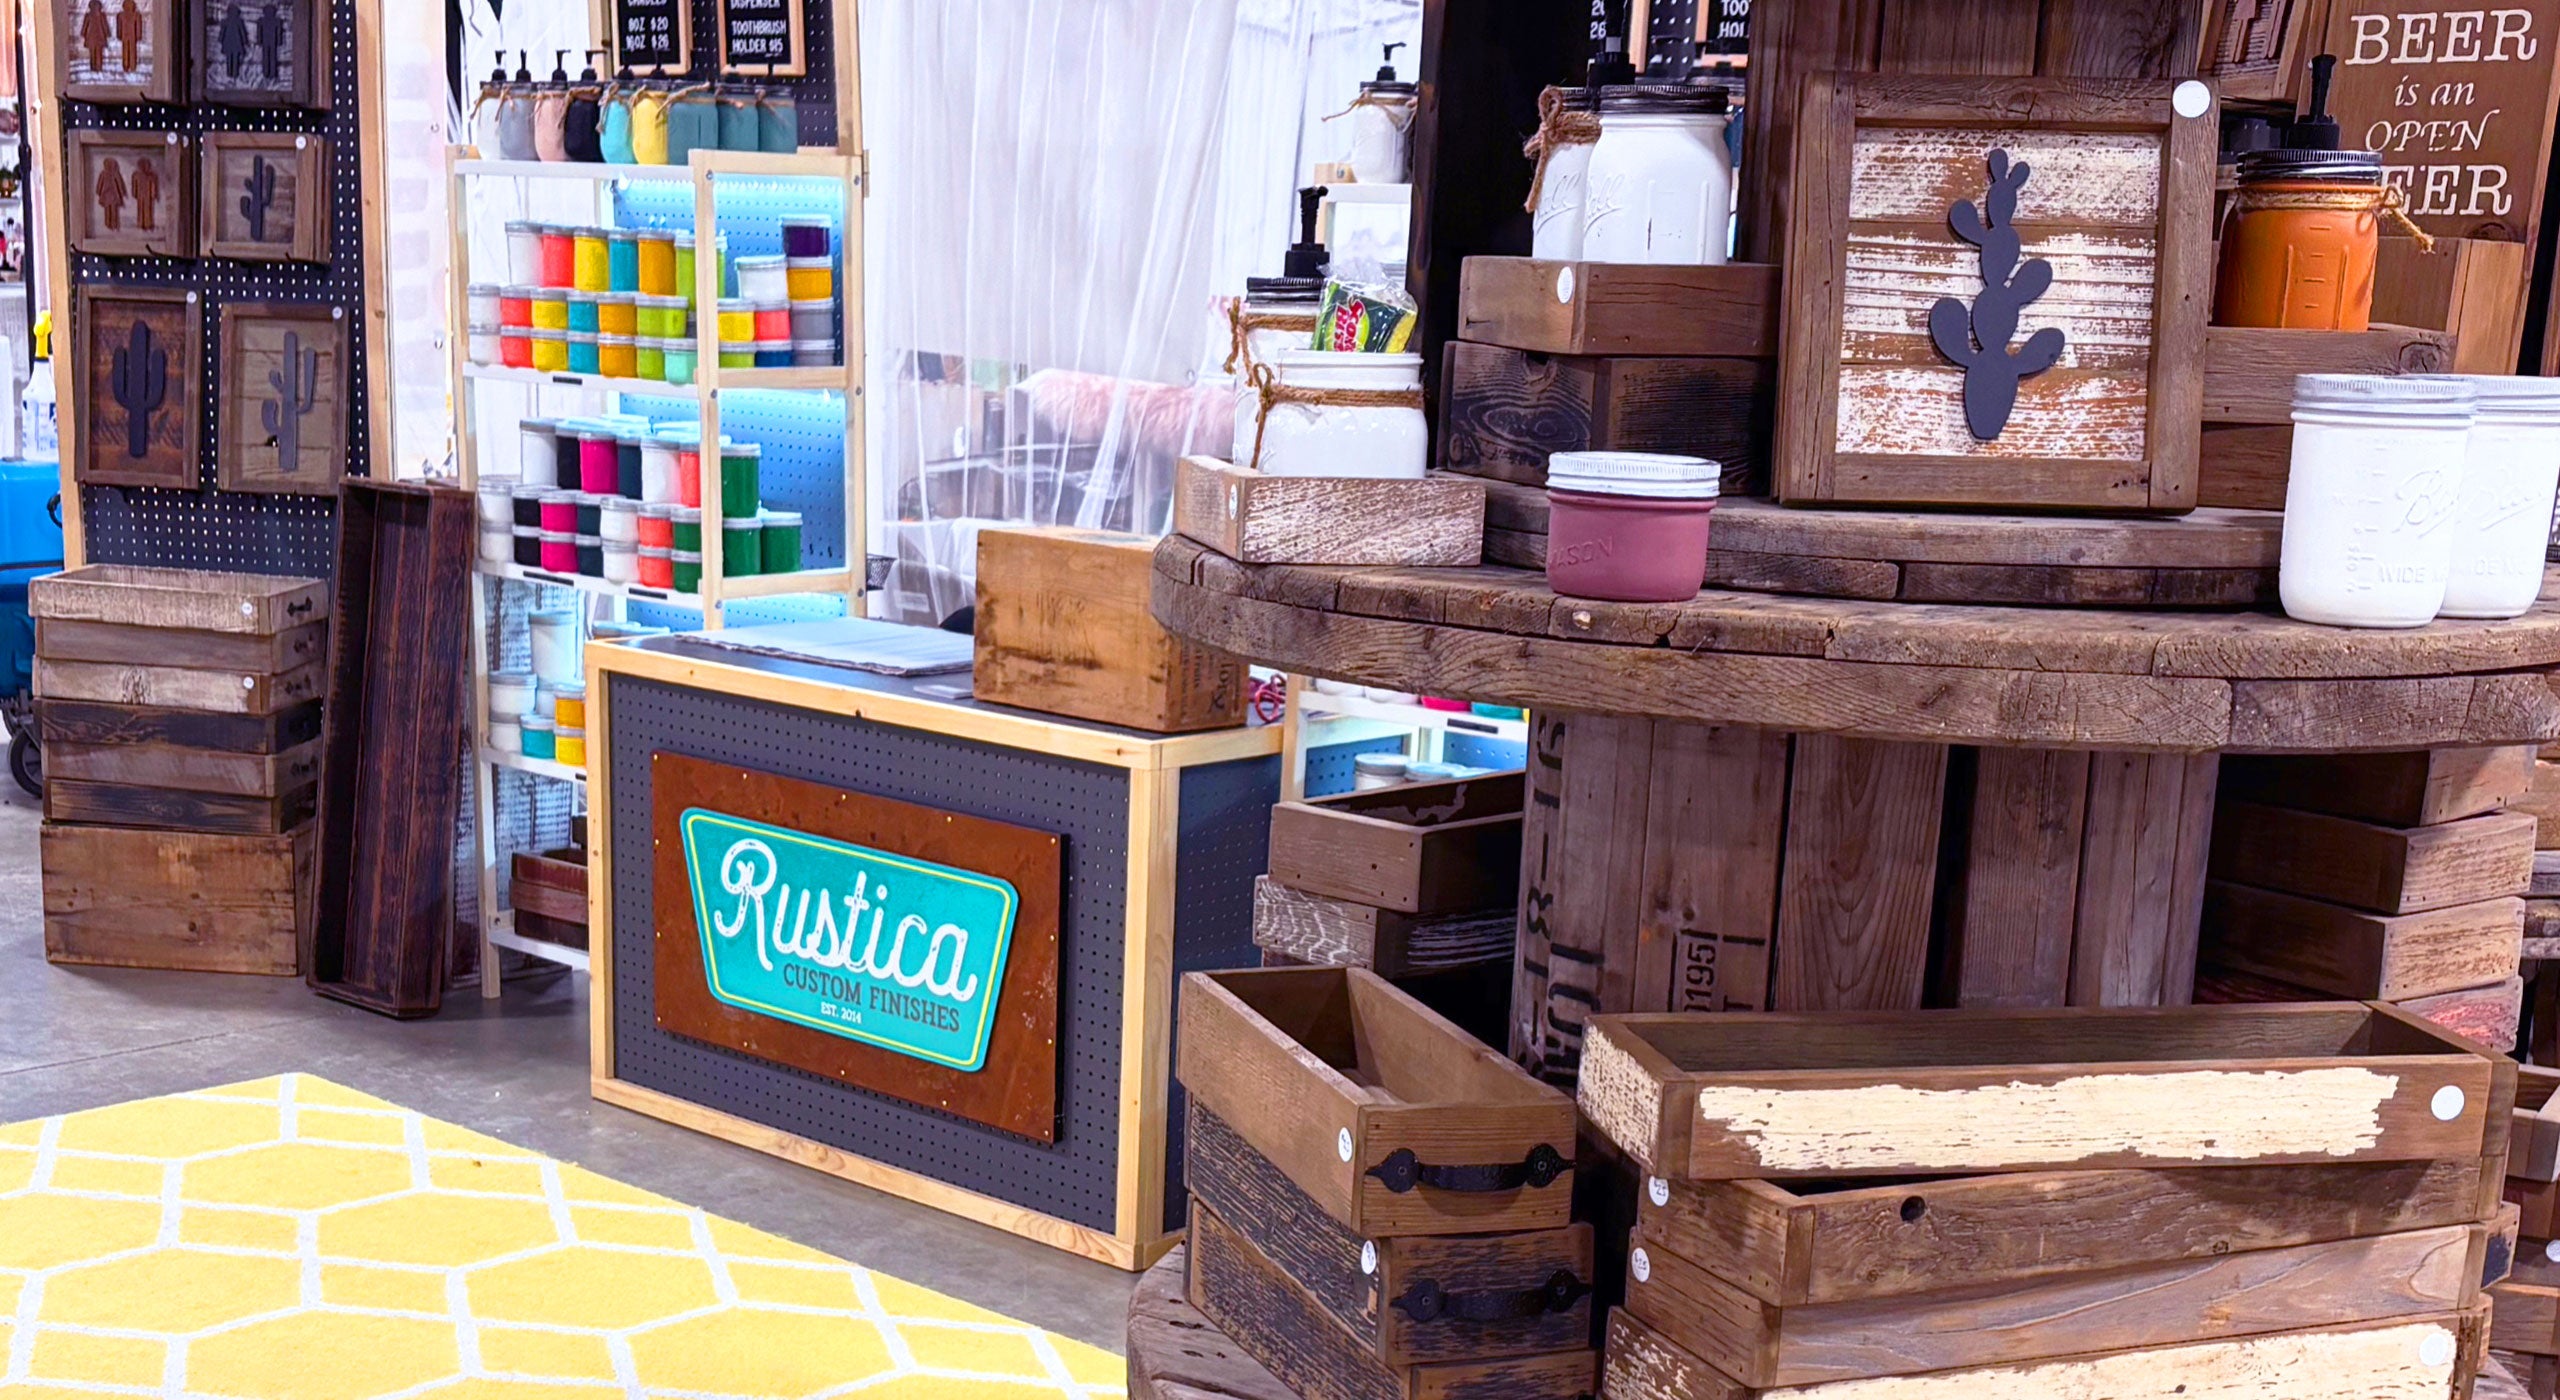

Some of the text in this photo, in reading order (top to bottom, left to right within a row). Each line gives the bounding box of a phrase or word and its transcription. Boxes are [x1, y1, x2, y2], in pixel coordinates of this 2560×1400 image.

[732, 20, 787, 35] TOOTHBRUSH
[732, 39, 767, 53] HOLDER
[2345, 9, 2537, 65] BEER
[2395, 75, 2475, 107] is an
[2366, 110, 2500, 152] OPEN
[2383, 164, 2512, 216] EER
[714, 838, 978, 1001] Rustica
[783, 962, 960, 1033] CUSTOM FINISHES
[821, 1001, 862, 1025] EST. 2014
